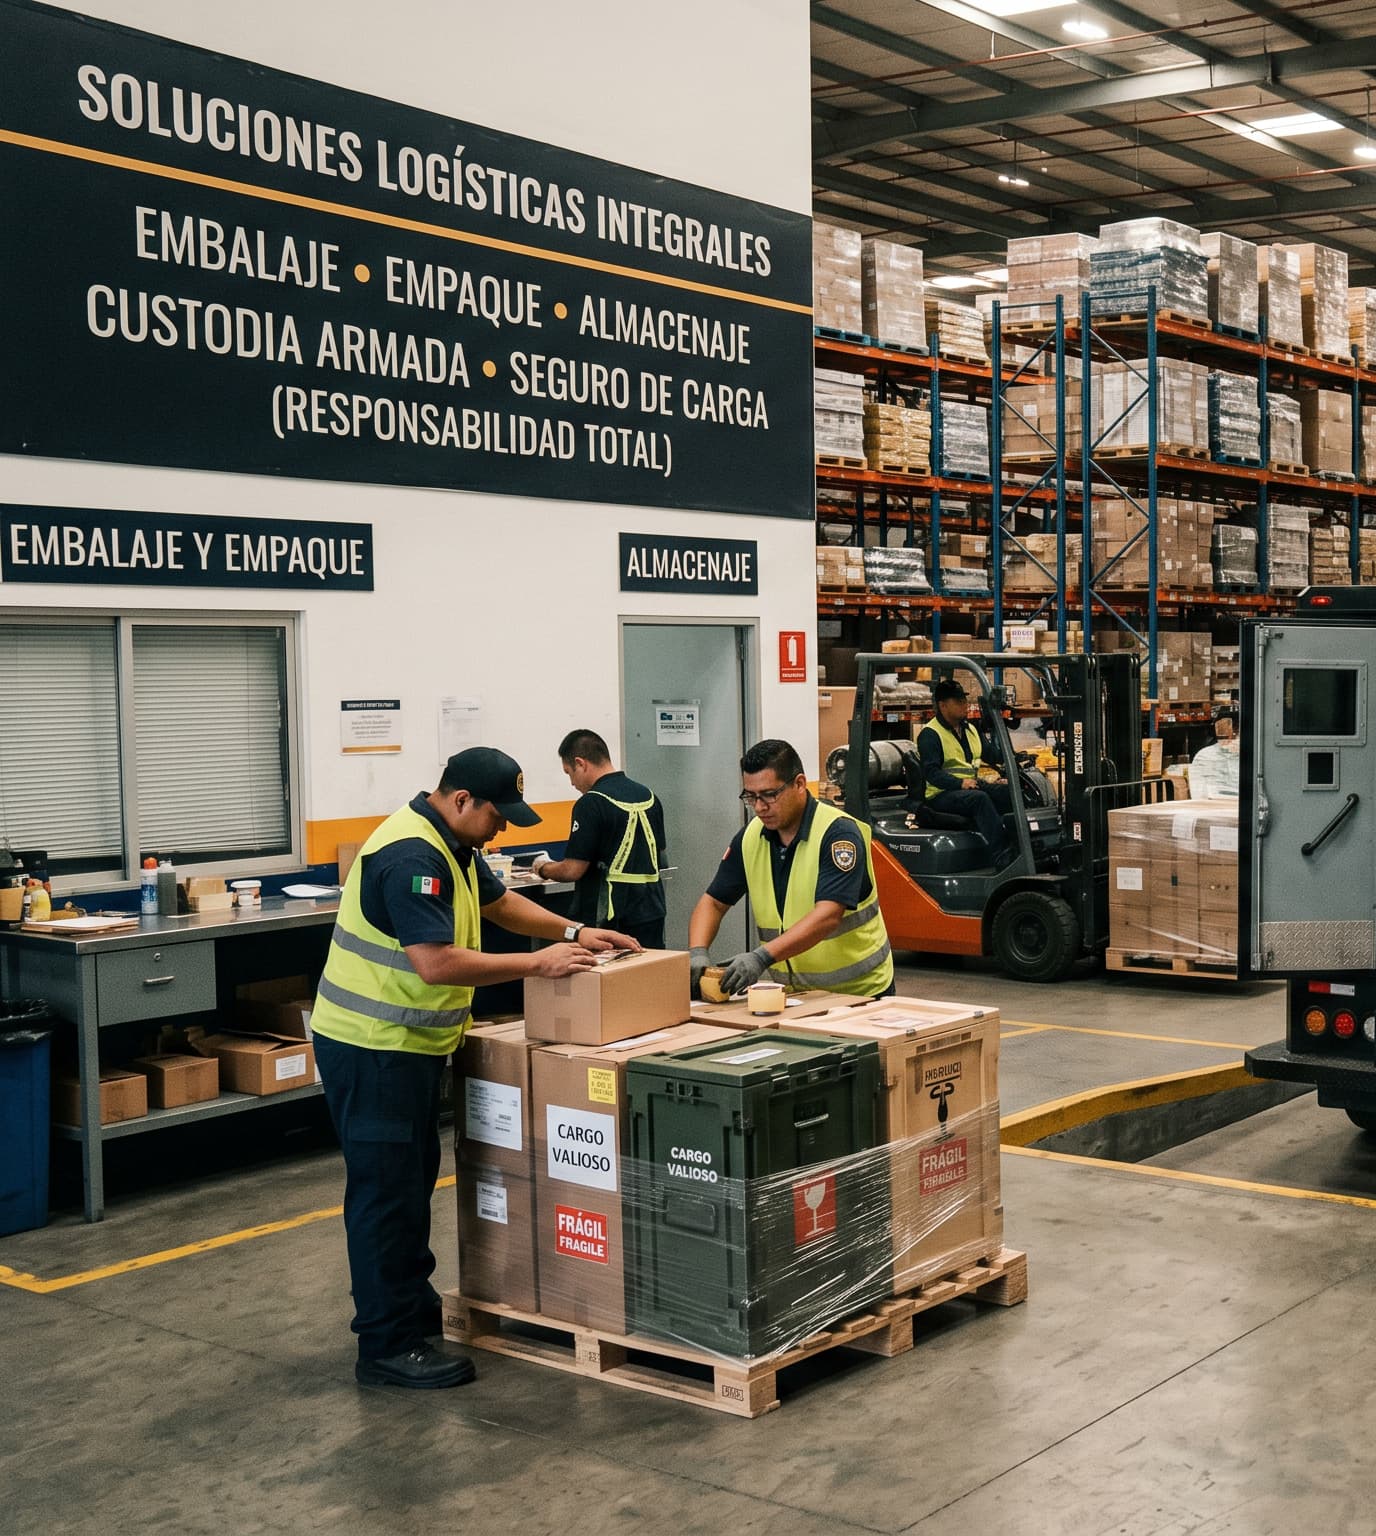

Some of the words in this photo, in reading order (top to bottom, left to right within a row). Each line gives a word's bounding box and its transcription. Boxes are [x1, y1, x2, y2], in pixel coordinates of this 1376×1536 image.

[77, 64, 363, 182] SOLUCIONES
[377, 140, 586, 234] LOGÍSTICAS
[597, 195, 772, 277] INTEGRALES
[135, 205, 341, 292] EMBALAJE
[386, 256, 543, 328] EMPAQUE
[579, 294, 751, 365] ALMACENAJE
[86, 284, 304, 365] CUSTODIA
[316, 320, 471, 388] ARMADA
[509, 351, 630, 409] SEGURO
[640, 371, 674, 416] DE
[682, 379, 769, 430] CARGA
[271, 384, 576, 460] (RESPONSABILIDAD
[584, 423, 672, 477] TOTAL)
[10, 523, 184, 569] EMBALAJE
[192, 532, 214, 571] Y
[225, 533, 365, 580] EMPAQUE
[627, 547, 752, 582] ALMACENAJE
[557, 1123, 604, 1146] CARGO
[552, 1147, 611, 1172] VALIOSO
[670, 1146, 712, 1165] CARGO
[667, 1162, 718, 1183] VALIOSO
[558, 1211, 606, 1241] FRÁGIL
[559, 1235, 605, 1257] FRAGILE
